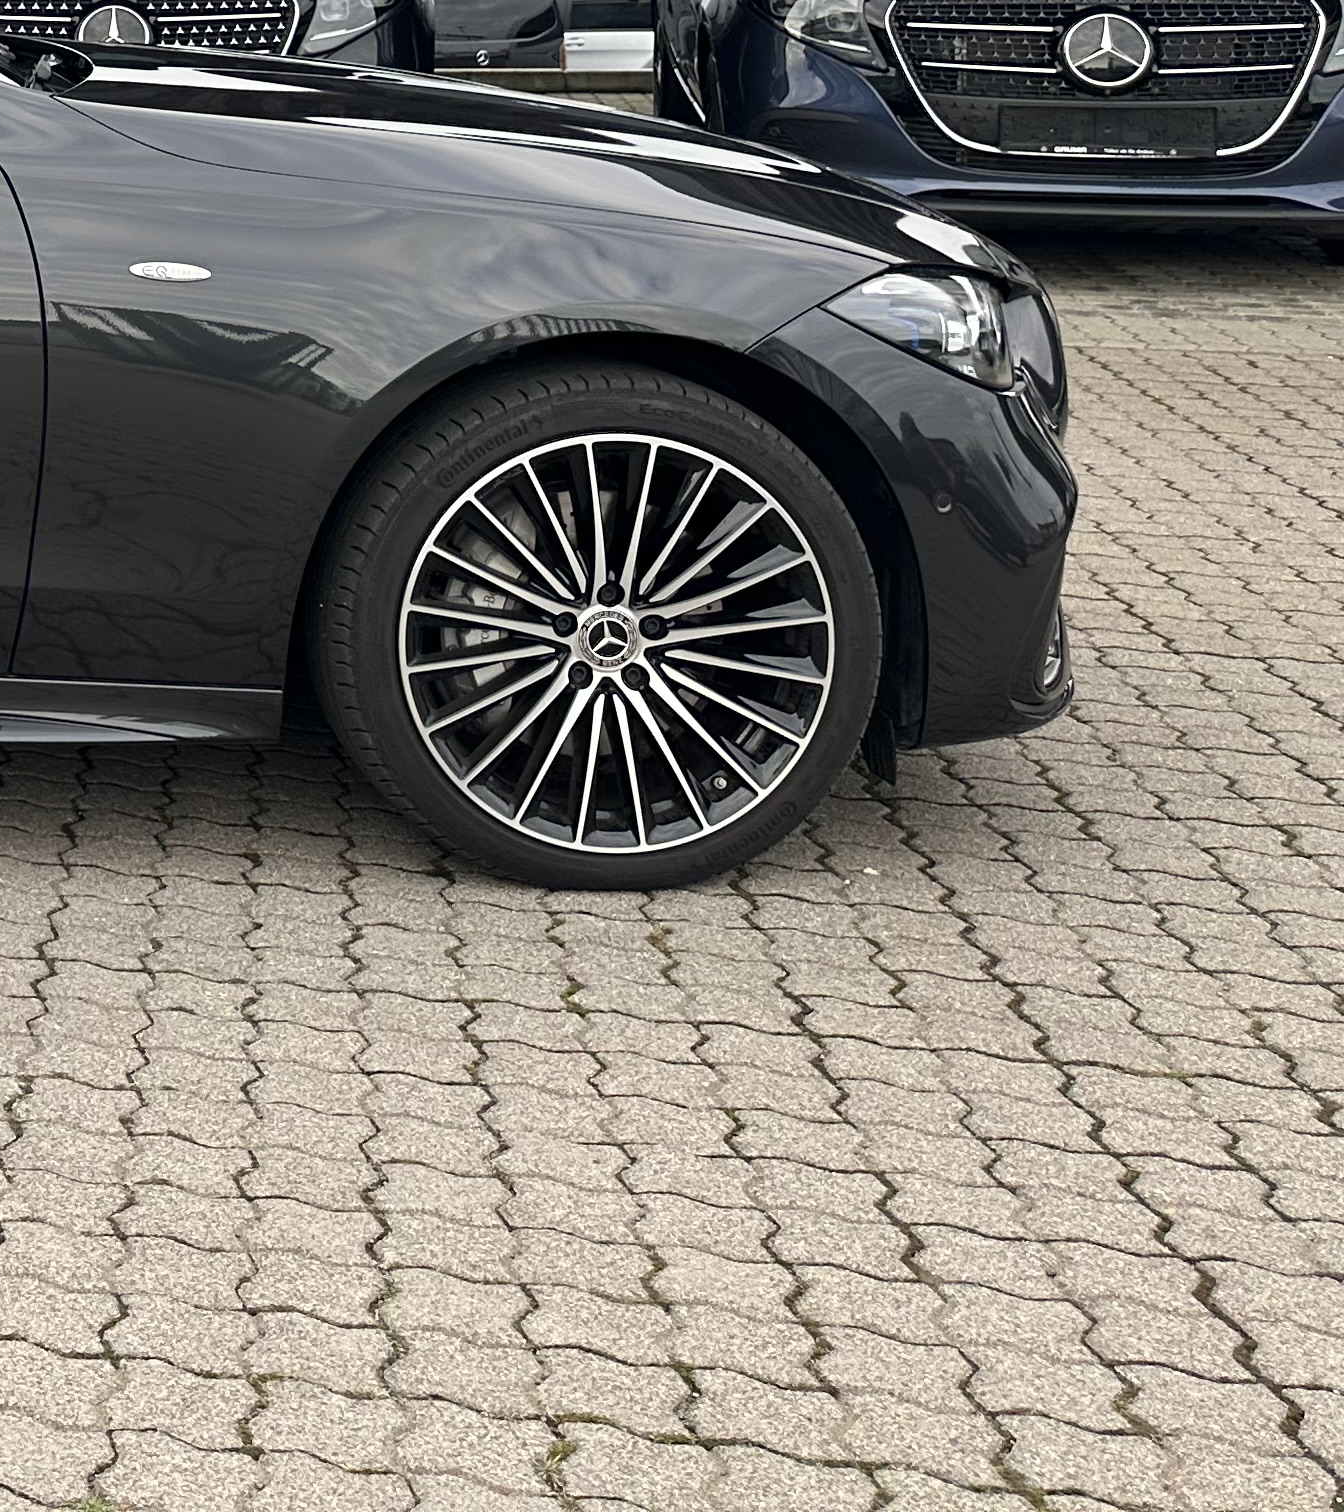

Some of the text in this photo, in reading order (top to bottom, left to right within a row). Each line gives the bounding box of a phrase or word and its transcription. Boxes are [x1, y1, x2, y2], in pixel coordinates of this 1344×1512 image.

[142, 264, 172, 278] EQ
[434, 415, 530, 490] Continental
[639, 402, 756, 453] EcoContact
